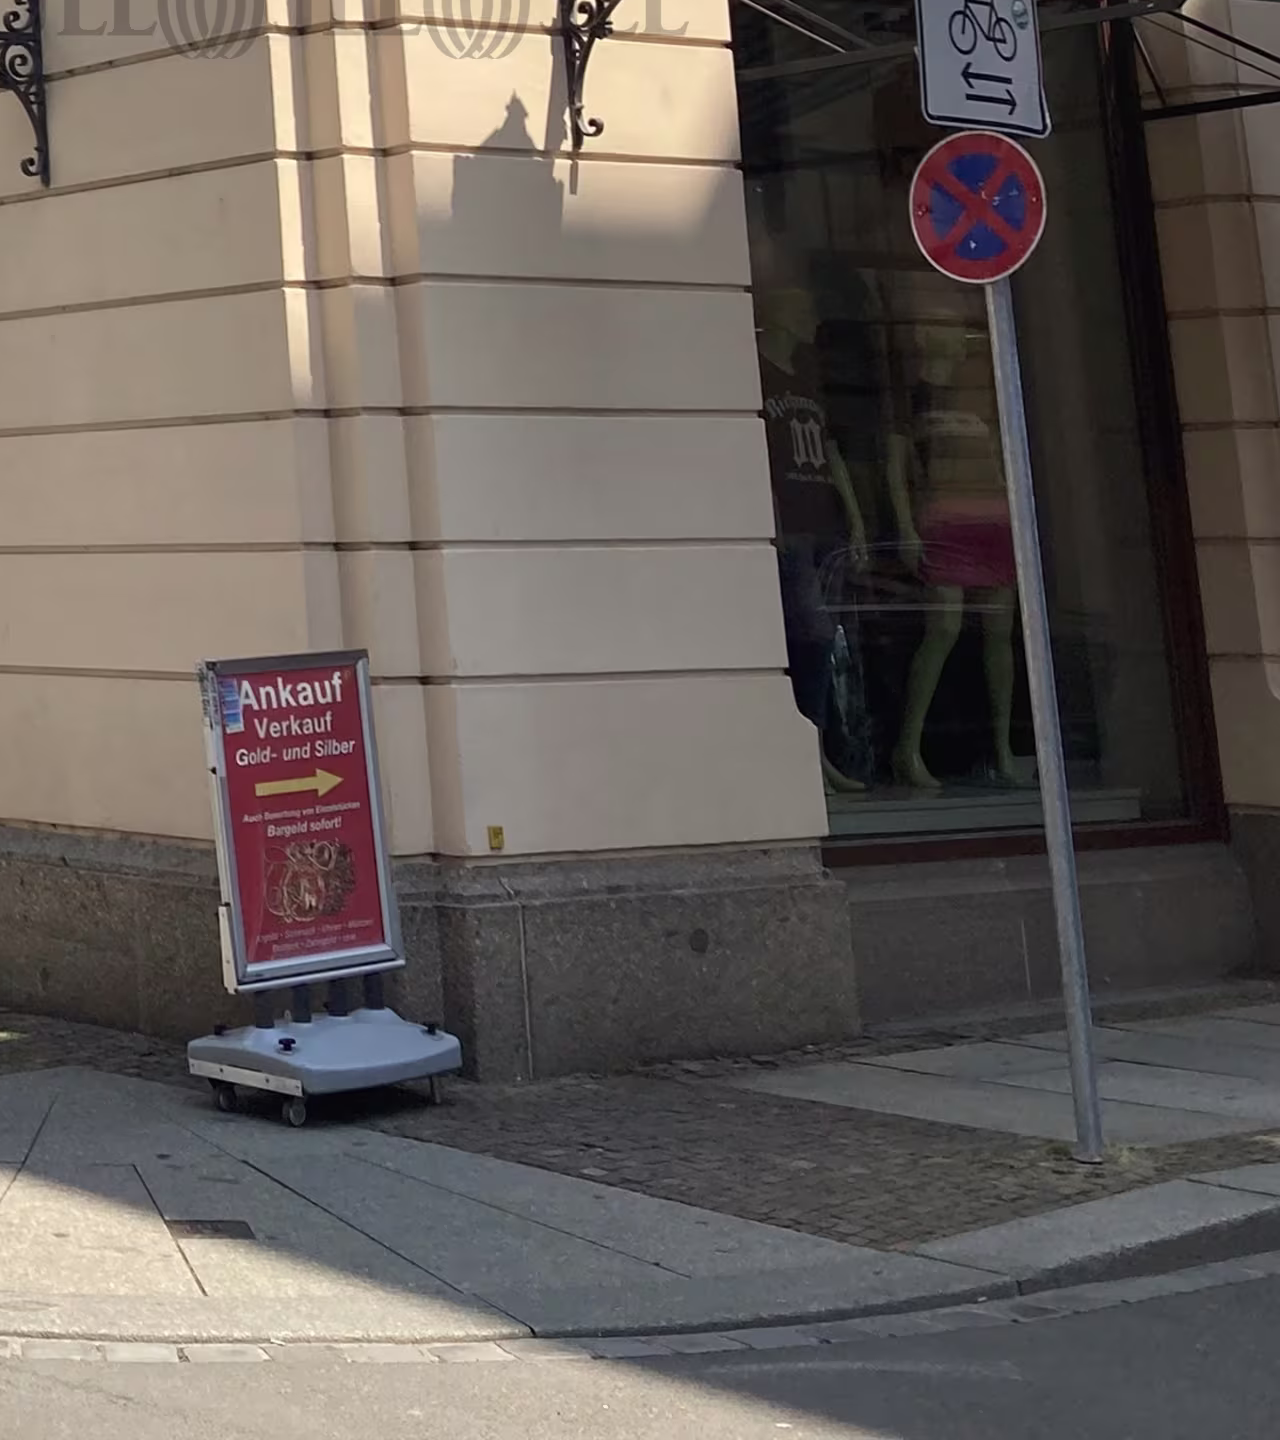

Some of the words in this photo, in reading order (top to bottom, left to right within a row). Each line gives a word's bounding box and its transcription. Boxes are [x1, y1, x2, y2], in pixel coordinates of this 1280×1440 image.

[239, 671, 342, 711] Ankauf
[253, 710, 332, 739] Verkauf
[236, 746, 278, 766] Gold-
[283, 742, 311, 761] und
[314, 739, 355, 757] Silber
[267, 821, 307, 838] Bargeld
[309, 816, 342, 832] sofort!
